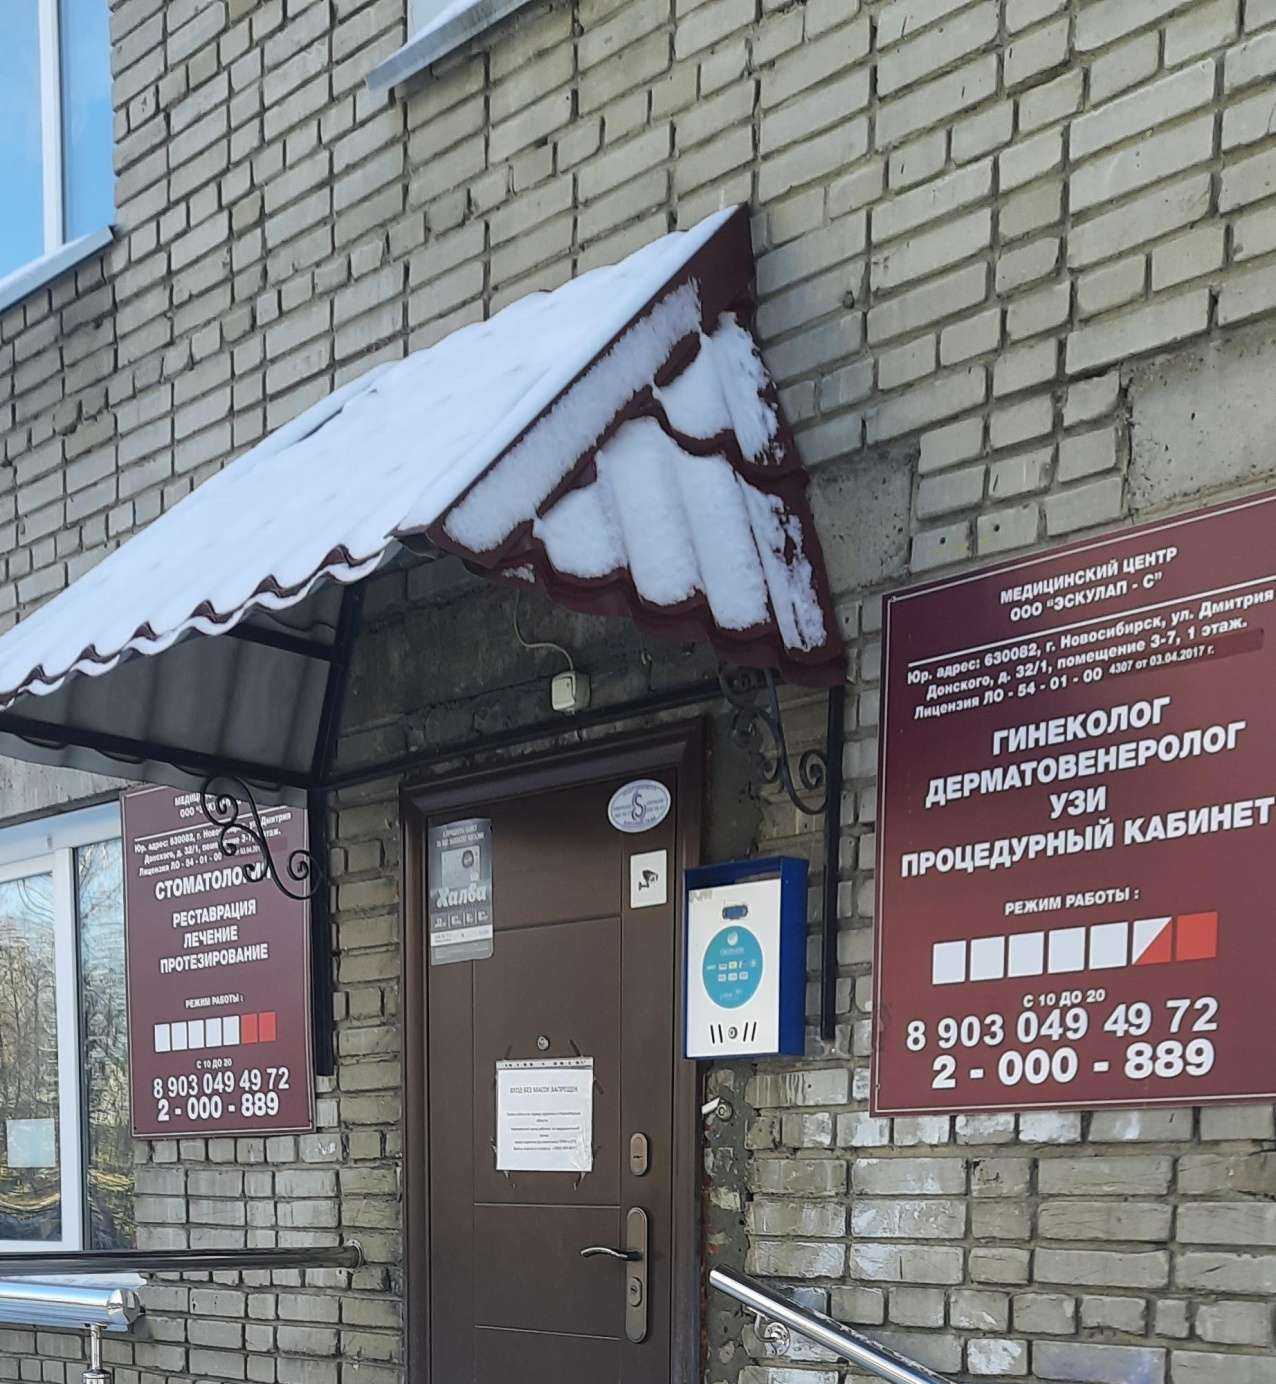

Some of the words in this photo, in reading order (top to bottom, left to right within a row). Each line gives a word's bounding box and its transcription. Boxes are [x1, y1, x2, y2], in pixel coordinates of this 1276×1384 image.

[1000, 559, 1118, 604] МЕДИЦИНСКИЙ
[1123, 547, 1178, 574] ЦЕНТР
[1010, 602, 1043, 622] ООО
[907, 671, 932, 685] Юр.
[937, 659, 980, 679] адрес:
[984, 642, 1041, 666] 630082,
[1045, 641, 1055, 652] г.
[1061, 615, 1167, 649] Новосибирск,
[1171, 609, 1194, 625] ул.
[1199, 589, 1274, 619] Дмитрия
[926, 675, 994, 701] Донского,
[998, 671, 1011, 685] д.
[1016, 660, 1052, 679] 32/1,
[1057, 640, 1146, 669] помещение
[1150, 630, 1181, 649] 3-7,
[1187, 626, 1196, 640] 1
[1202, 616, 1248, 637] этаж.
[914, 695, 979, 720] Лицензия
[983, 689, 1004, 706] ЛО
[1018, 682, 1036, 697] 54
[1050, 675, 1067, 690] 01
[1083, 668, 1102, 683] 00
[1109, 660, 1133, 675] 4307
[1135, 659, 1148, 669] от
[1149, 645, 1204, 667] 03.04.2017
[1207, 645, 1215, 655] г.
[992, 696, 1171, 756] ГИНЕКОЛОГ
[925, 721, 1247, 809] ДЕРМАТОВЕНЕРОЛОГ
[1049, 786, 1107, 820] УЗИ
[901, 819, 1114, 877] ПРОЦЕДУРНЫЙ
[1124, 797, 1275, 845] КАБИНЕТ
[155, 861, 271, 900] СТОМАТОЛОИ
[173, 899, 256, 928] РЕСТАВРАЦИЯ
[1004, 896, 1062, 916] РЕЖИМ
[1065, 887, 1130, 908] РАБОТЫ
[184, 925, 238, 948] ЛЕЧЕНИЕ
[160, 943, 269, 973] ПРОТЕЗИРОВАНИЕ
[1023, 994, 1034, 1008] С
[1039, 993, 1056, 1006] 10
[1059, 990, 1082, 1007] ДО
[1086, 988, 1105, 1003] 20
[906, 1020, 926, 1051] 8
[937, 1014, 1004, 1049] 903
[1017, 1006, 1089, 1044] 049
[1104, 1003, 1151, 1037] 49
[1166, 997, 1219, 1033] 72
[204, 1060, 211, 1068] 10
[212, 1059, 222, 1070] ДО
[931, 1054, 957, 1089] 2
[999, 1047, 1078, 1086] 000
[1124, 1038, 1215, 1079] 889
[154, 1078, 163, 1099] 8
[168, 1074, 198, 1097] 903
[203, 1071, 234, 1094] 049
[239, 1069, 261, 1091] 49
[266, 1067, 289, 1089] 72
[157, 1099, 170, 1121] 2
[187, 1095, 222, 1120] 000
[241, 1092, 279, 1117] 889
